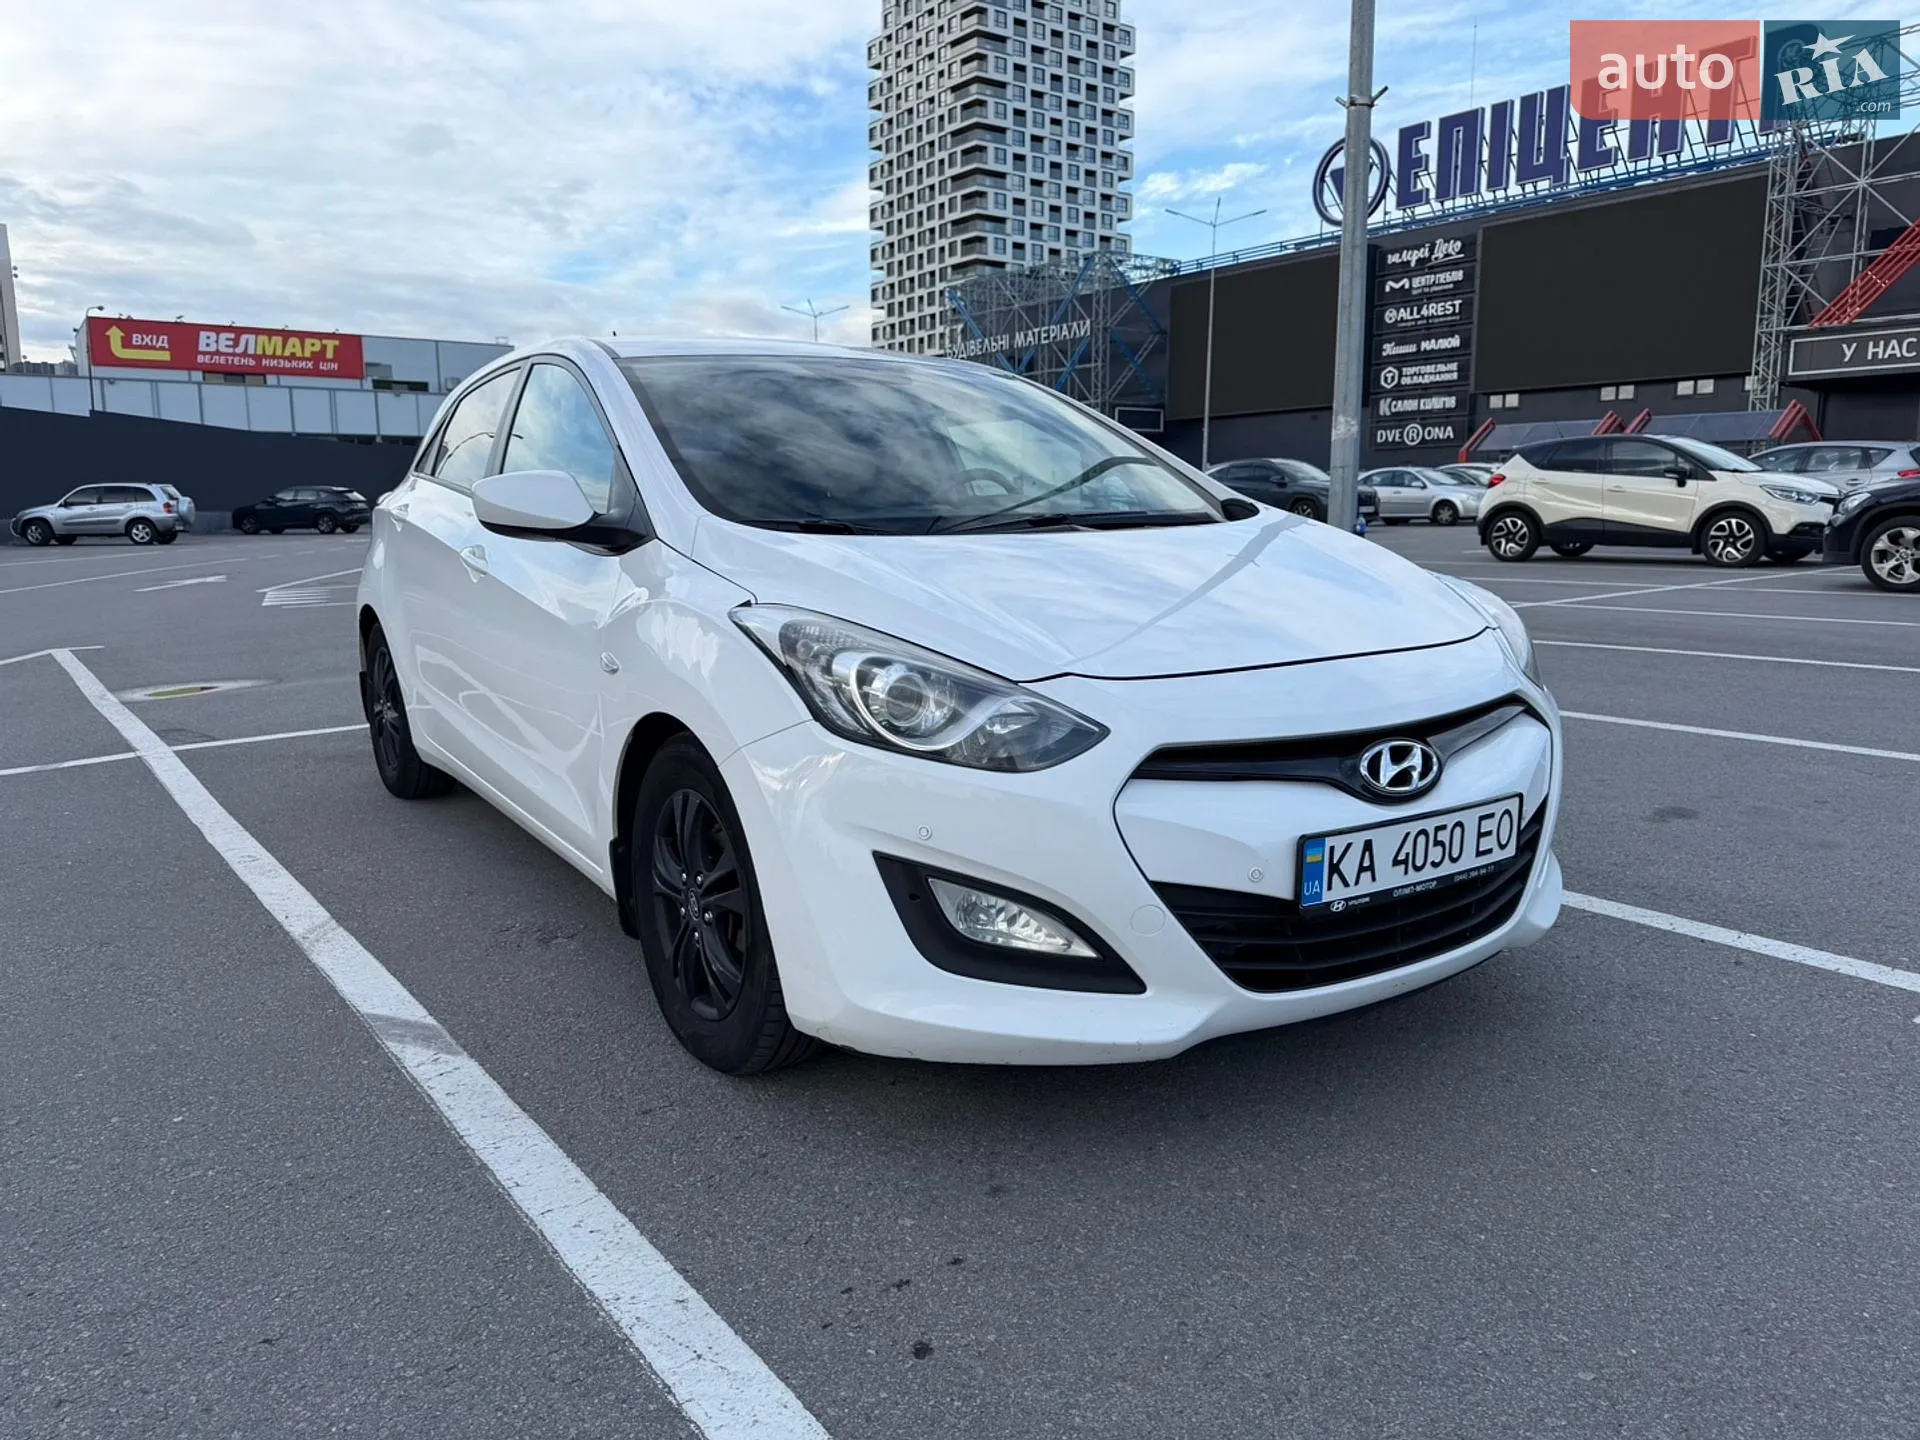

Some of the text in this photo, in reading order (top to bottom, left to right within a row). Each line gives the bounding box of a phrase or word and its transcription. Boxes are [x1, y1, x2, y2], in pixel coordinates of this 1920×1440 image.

[1397, 299, 1463, 321] ALL4REST
[131, 332, 170, 349] ВХІД
[198, 330, 340, 359] ВЕЛМАРТ
[946, 318, 1091, 360] БУДІВЕЛЬНІ МАТЕРІАЛИ
[1841, 337, 1918, 362] У НАС
[196, 353, 339, 371] ВЕЛЕТЕНЬ НИЗЬКИХ ЦІН
[1402, 362, 1458, 376] ТОРГОВЕЛЬНЕ
[1391, 399, 1418, 413] САЛОН
[1391, 820, 1466, 876] 4050
[1303, 878, 1321, 897] UA
